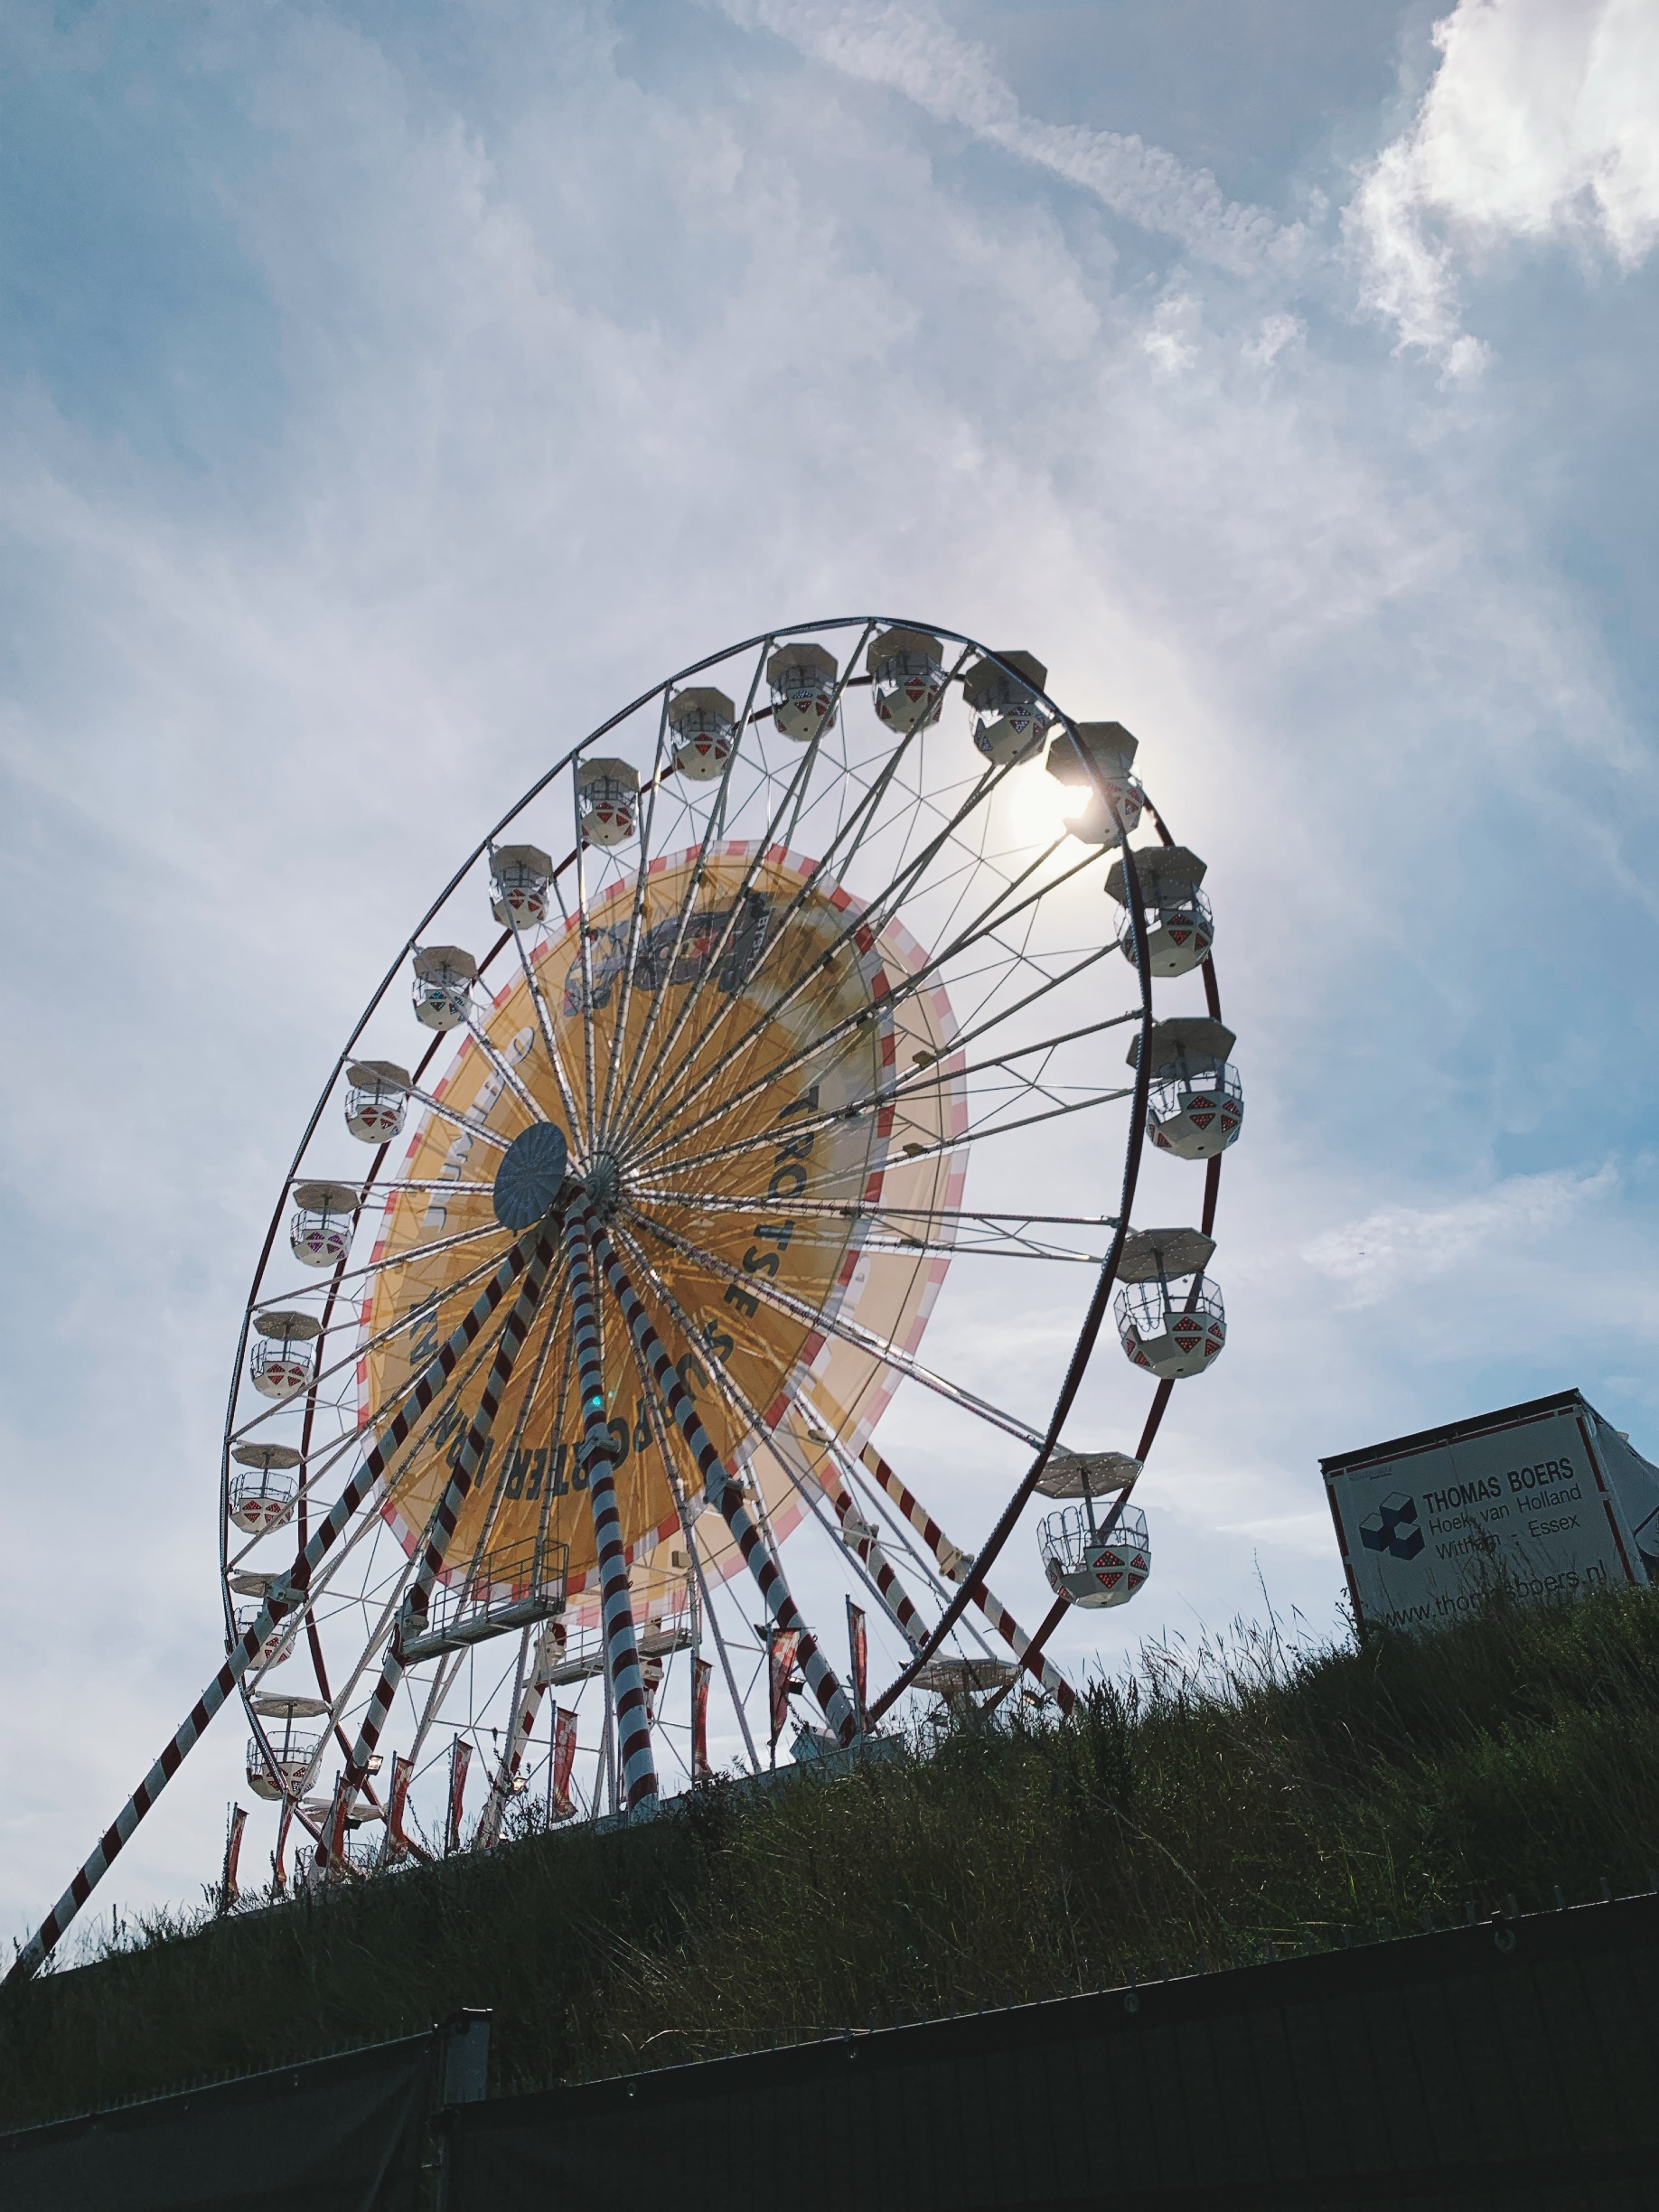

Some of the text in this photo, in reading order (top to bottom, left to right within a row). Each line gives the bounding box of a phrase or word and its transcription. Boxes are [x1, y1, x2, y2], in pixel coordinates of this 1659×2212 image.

[420, 1026, 535, 1233] JUMBO
[724, 1086, 820, 1319] TROTSE
[1422, 1457, 1575, 1514] THOMAS BOERS
[1429, 1483, 1582, 1536] Hoek van Holland
[1528, 1514, 1580, 1538] Essex
[1385, 1559, 1607, 1627] www.thomsboers.nl
